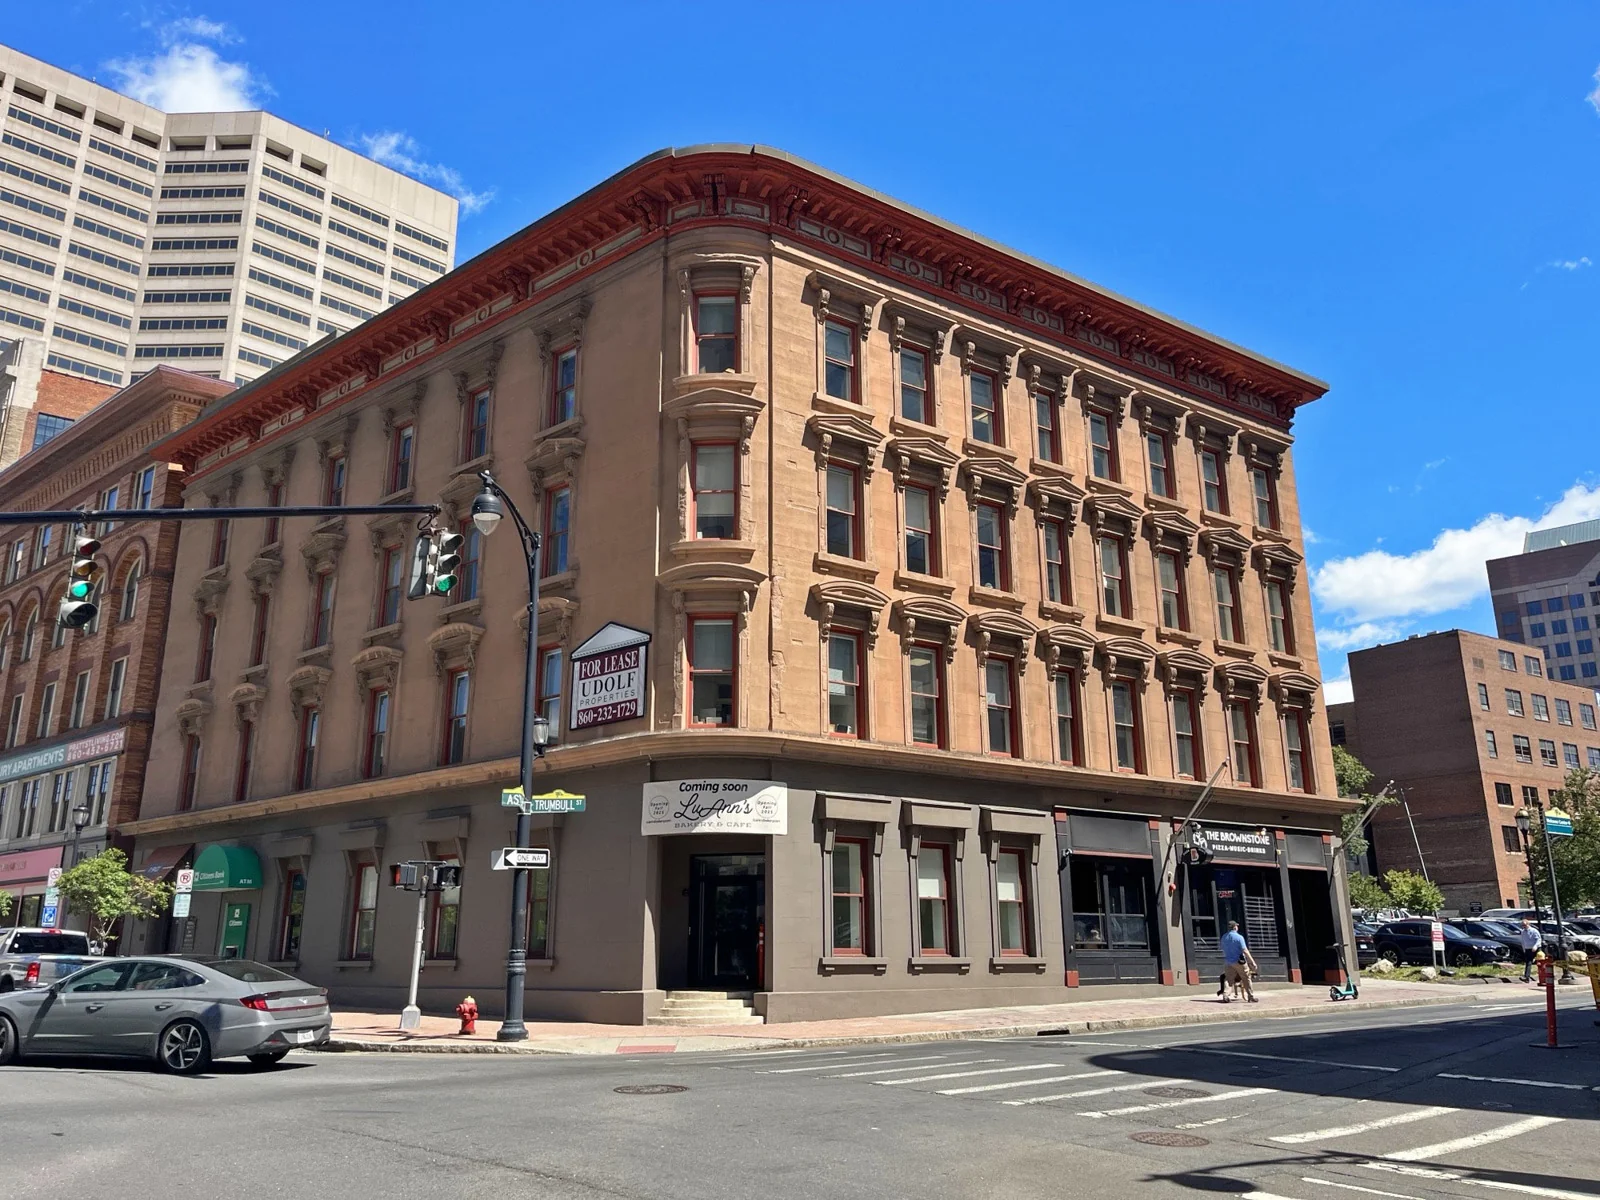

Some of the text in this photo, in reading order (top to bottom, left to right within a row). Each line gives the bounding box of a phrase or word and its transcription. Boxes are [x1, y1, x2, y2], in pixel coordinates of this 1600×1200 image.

[581, 650, 638, 678] FOR LEASE
[582, 671, 636, 697] UDOLF
[580, 689, 635, 706] PROPERTIES
[578, 701, 636, 725] 860-232-1729
[12, 749, 65, 773] APARTMENTS
[679, 781, 748, 793] Coming soon
[535, 800, 575, 810] TRUMBULL
[673, 793, 753, 821] LuAnn's
[674, 821, 714, 829] BAKERY
[1205, 831, 1270, 845] THE BROWNSTONE
[517, 854, 530, 862] ONE
